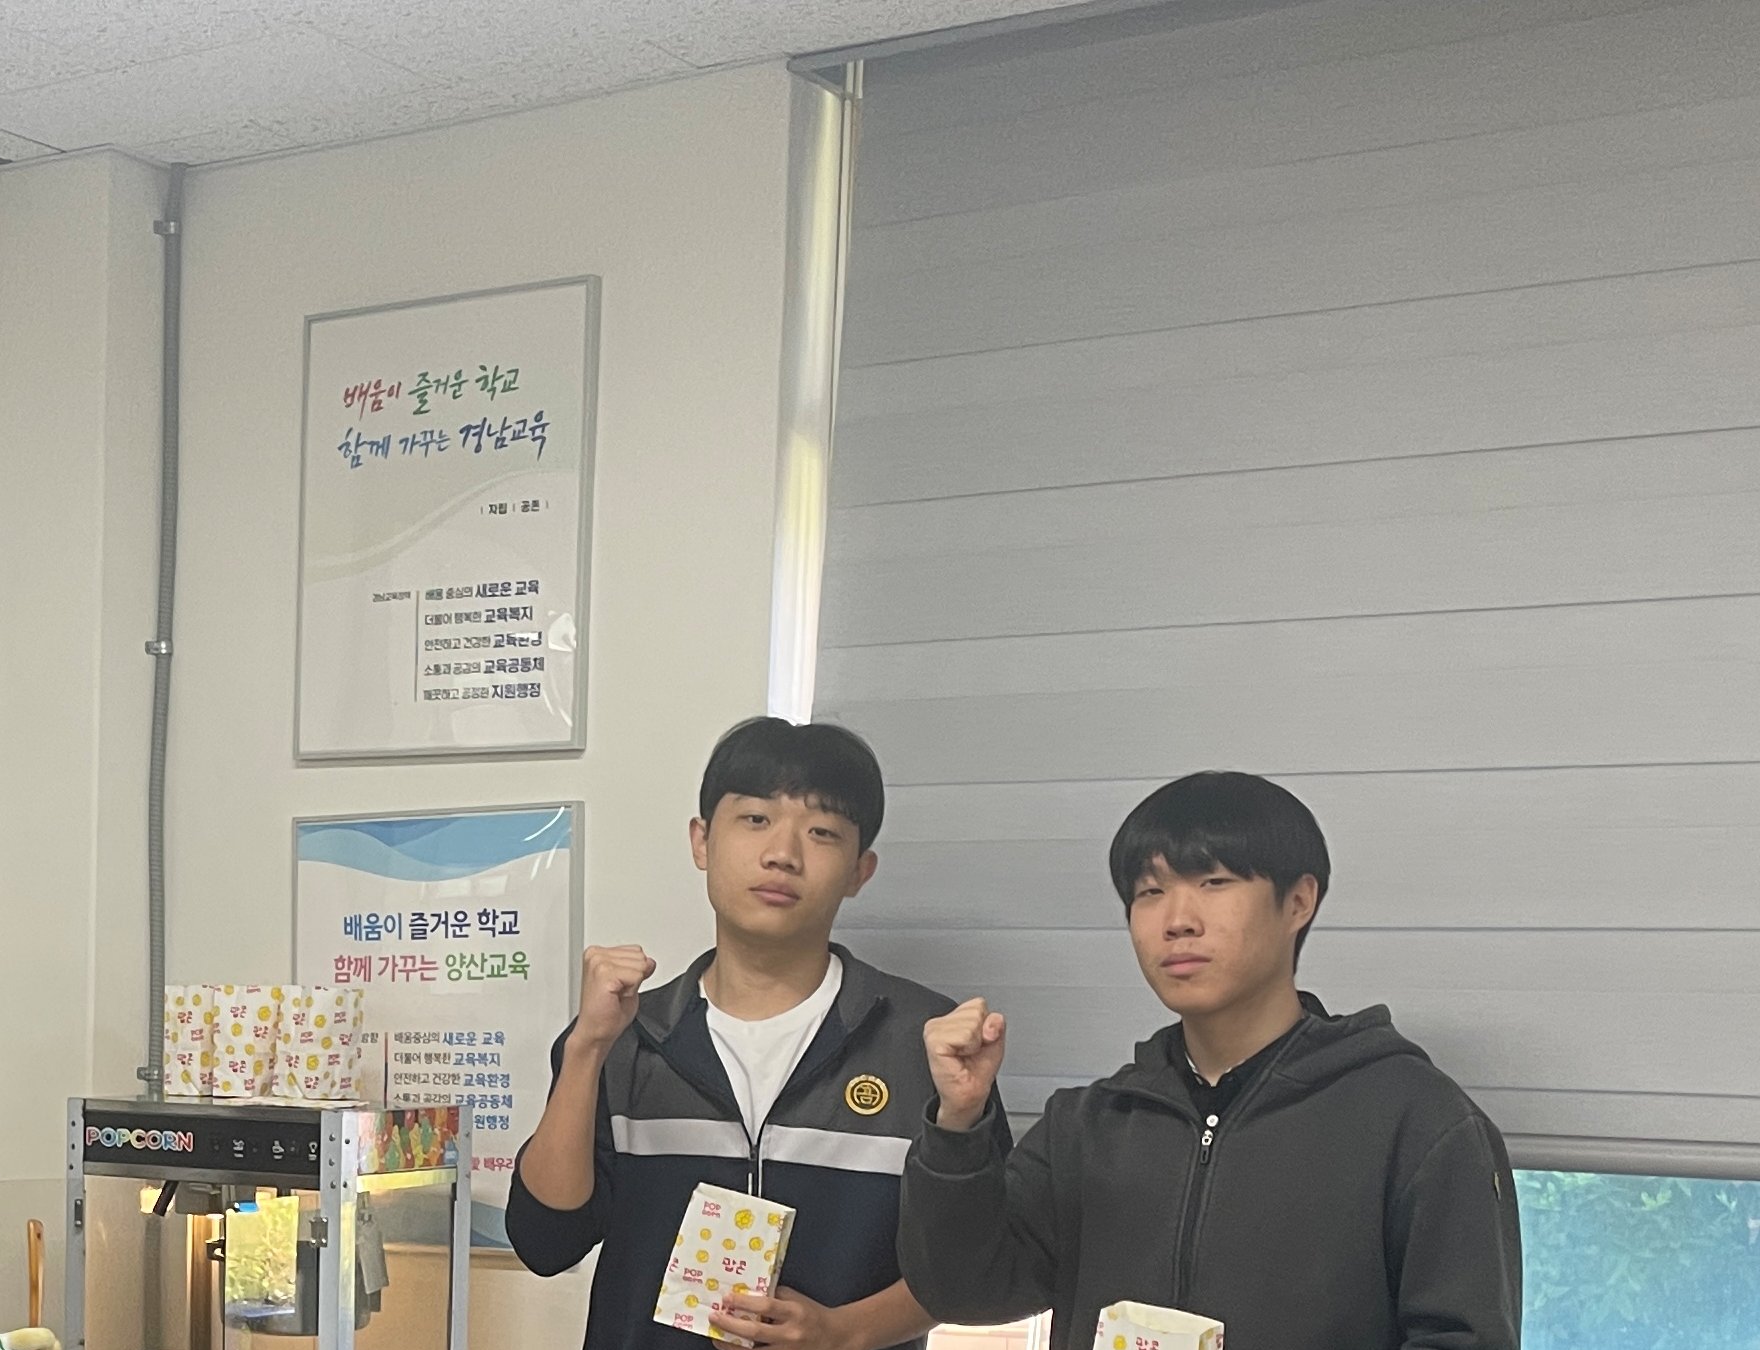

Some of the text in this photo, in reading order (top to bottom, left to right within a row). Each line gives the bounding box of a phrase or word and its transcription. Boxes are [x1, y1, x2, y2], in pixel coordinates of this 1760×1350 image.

[343, 365, 519, 421] 배움이 즐거운 학교
[337, 410, 550, 469] 함께 가꾸는 경남교육
[475, 582, 512, 598] 새로운
[514, 579, 539, 596] 교육
[484, 606, 533, 624] 교육복지
[483, 657, 545, 674] 교육공동체
[492, 683, 541, 699] 지원행정
[343, 908, 520, 941] 배움이 즐거운 학교
[334, 951, 530, 983] 함께 가꾸는 양산교육
[442, 1031, 478, 1047] 새로운
[481, 1031, 506, 1046] 교육
[394, 1052, 501, 1067] 더불어 행복한 교육복지
[393, 1073, 511, 1089] 안전하고 건강한 교육환경
[455, 1093, 513, 1110] 교육공동체
[473, 1115, 510, 1131] 원행정
[86, 1126, 195, 1152] POPCORN
